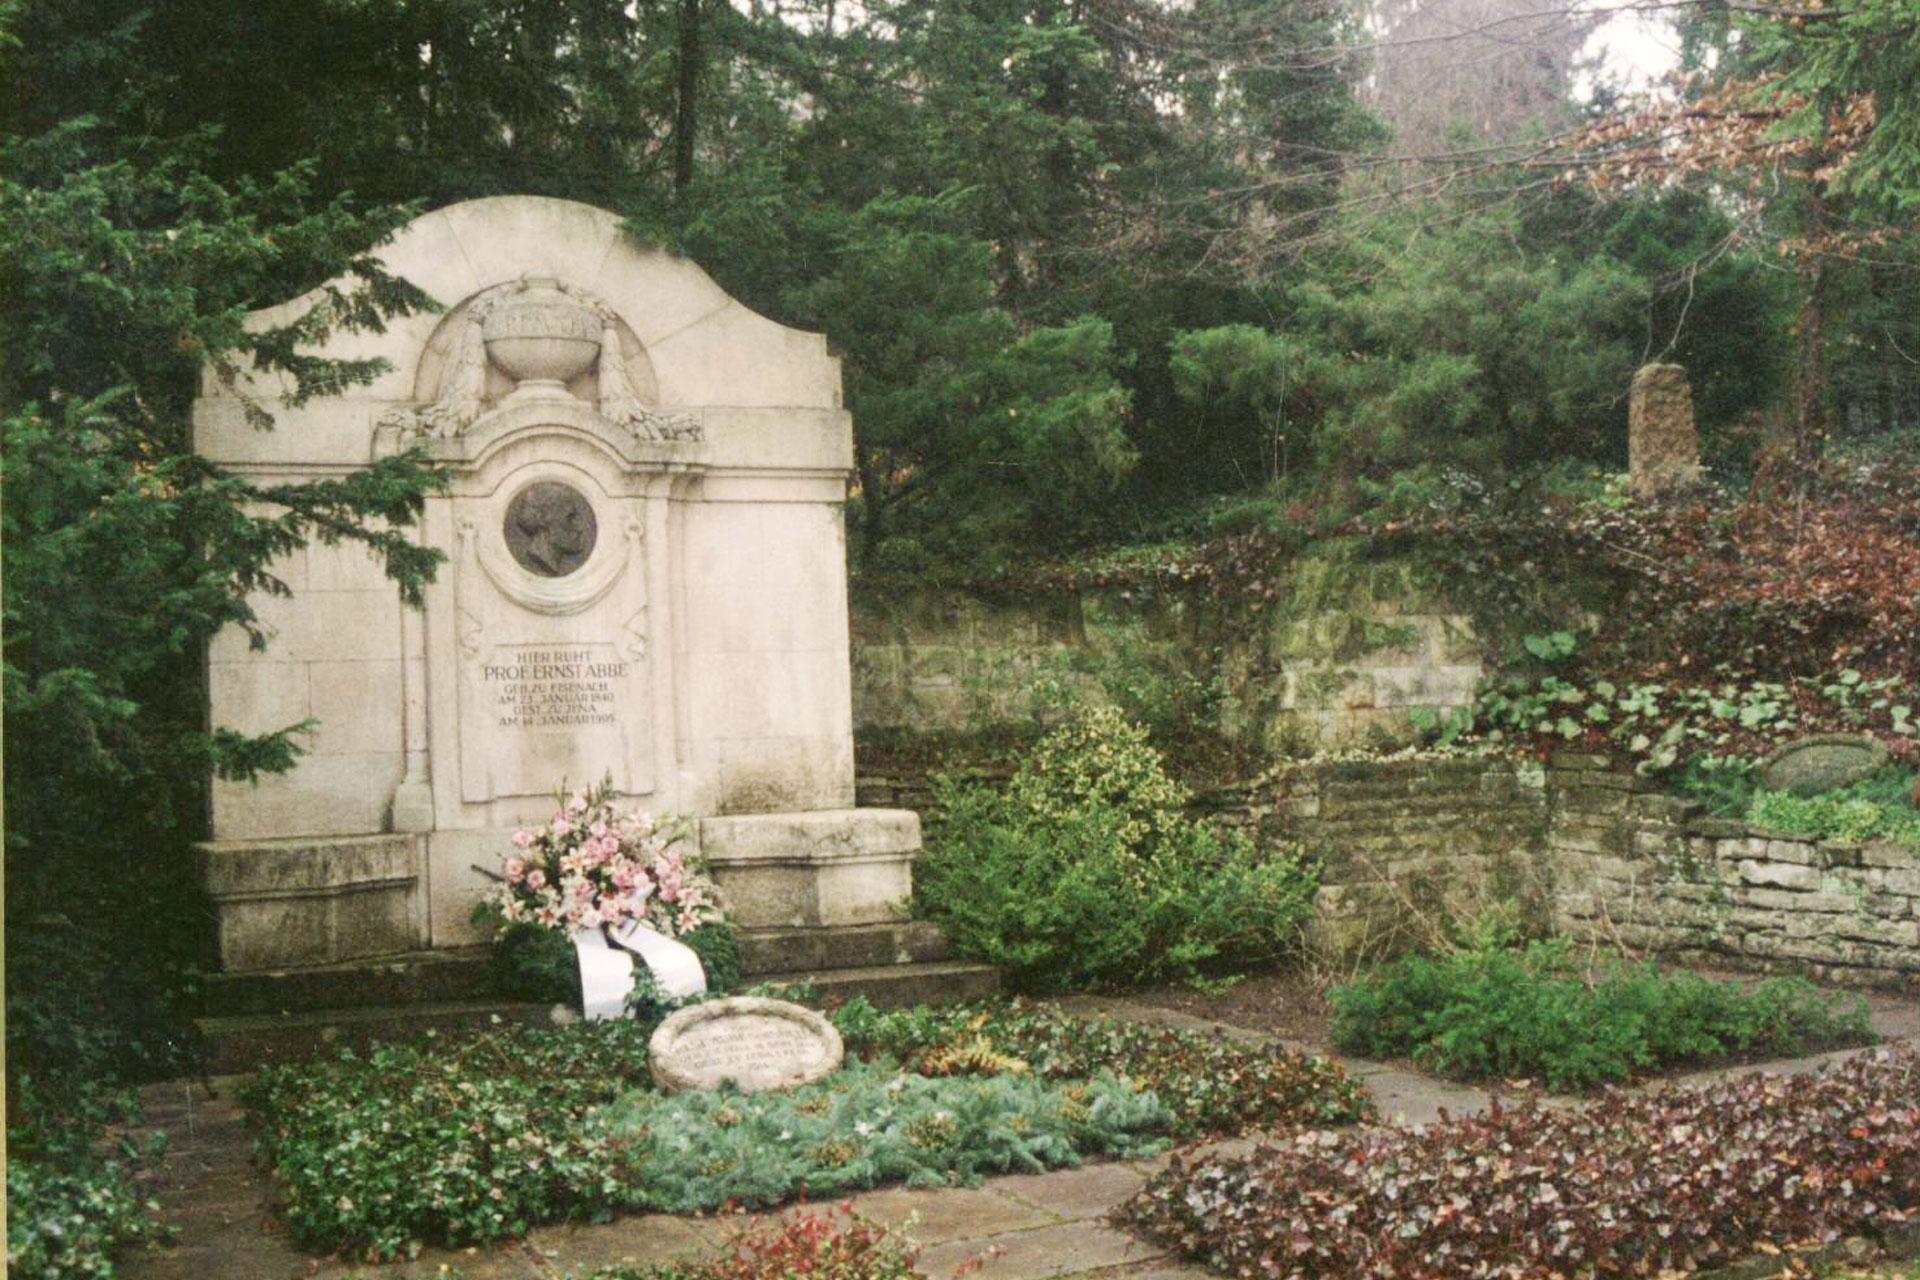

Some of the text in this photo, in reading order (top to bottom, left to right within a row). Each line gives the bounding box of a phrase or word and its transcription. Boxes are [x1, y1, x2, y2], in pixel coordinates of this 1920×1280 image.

[533, 664, 582, 680] ERNST
[585, 662, 629, 679] ABBE
[498, 694, 516, 704] AM
